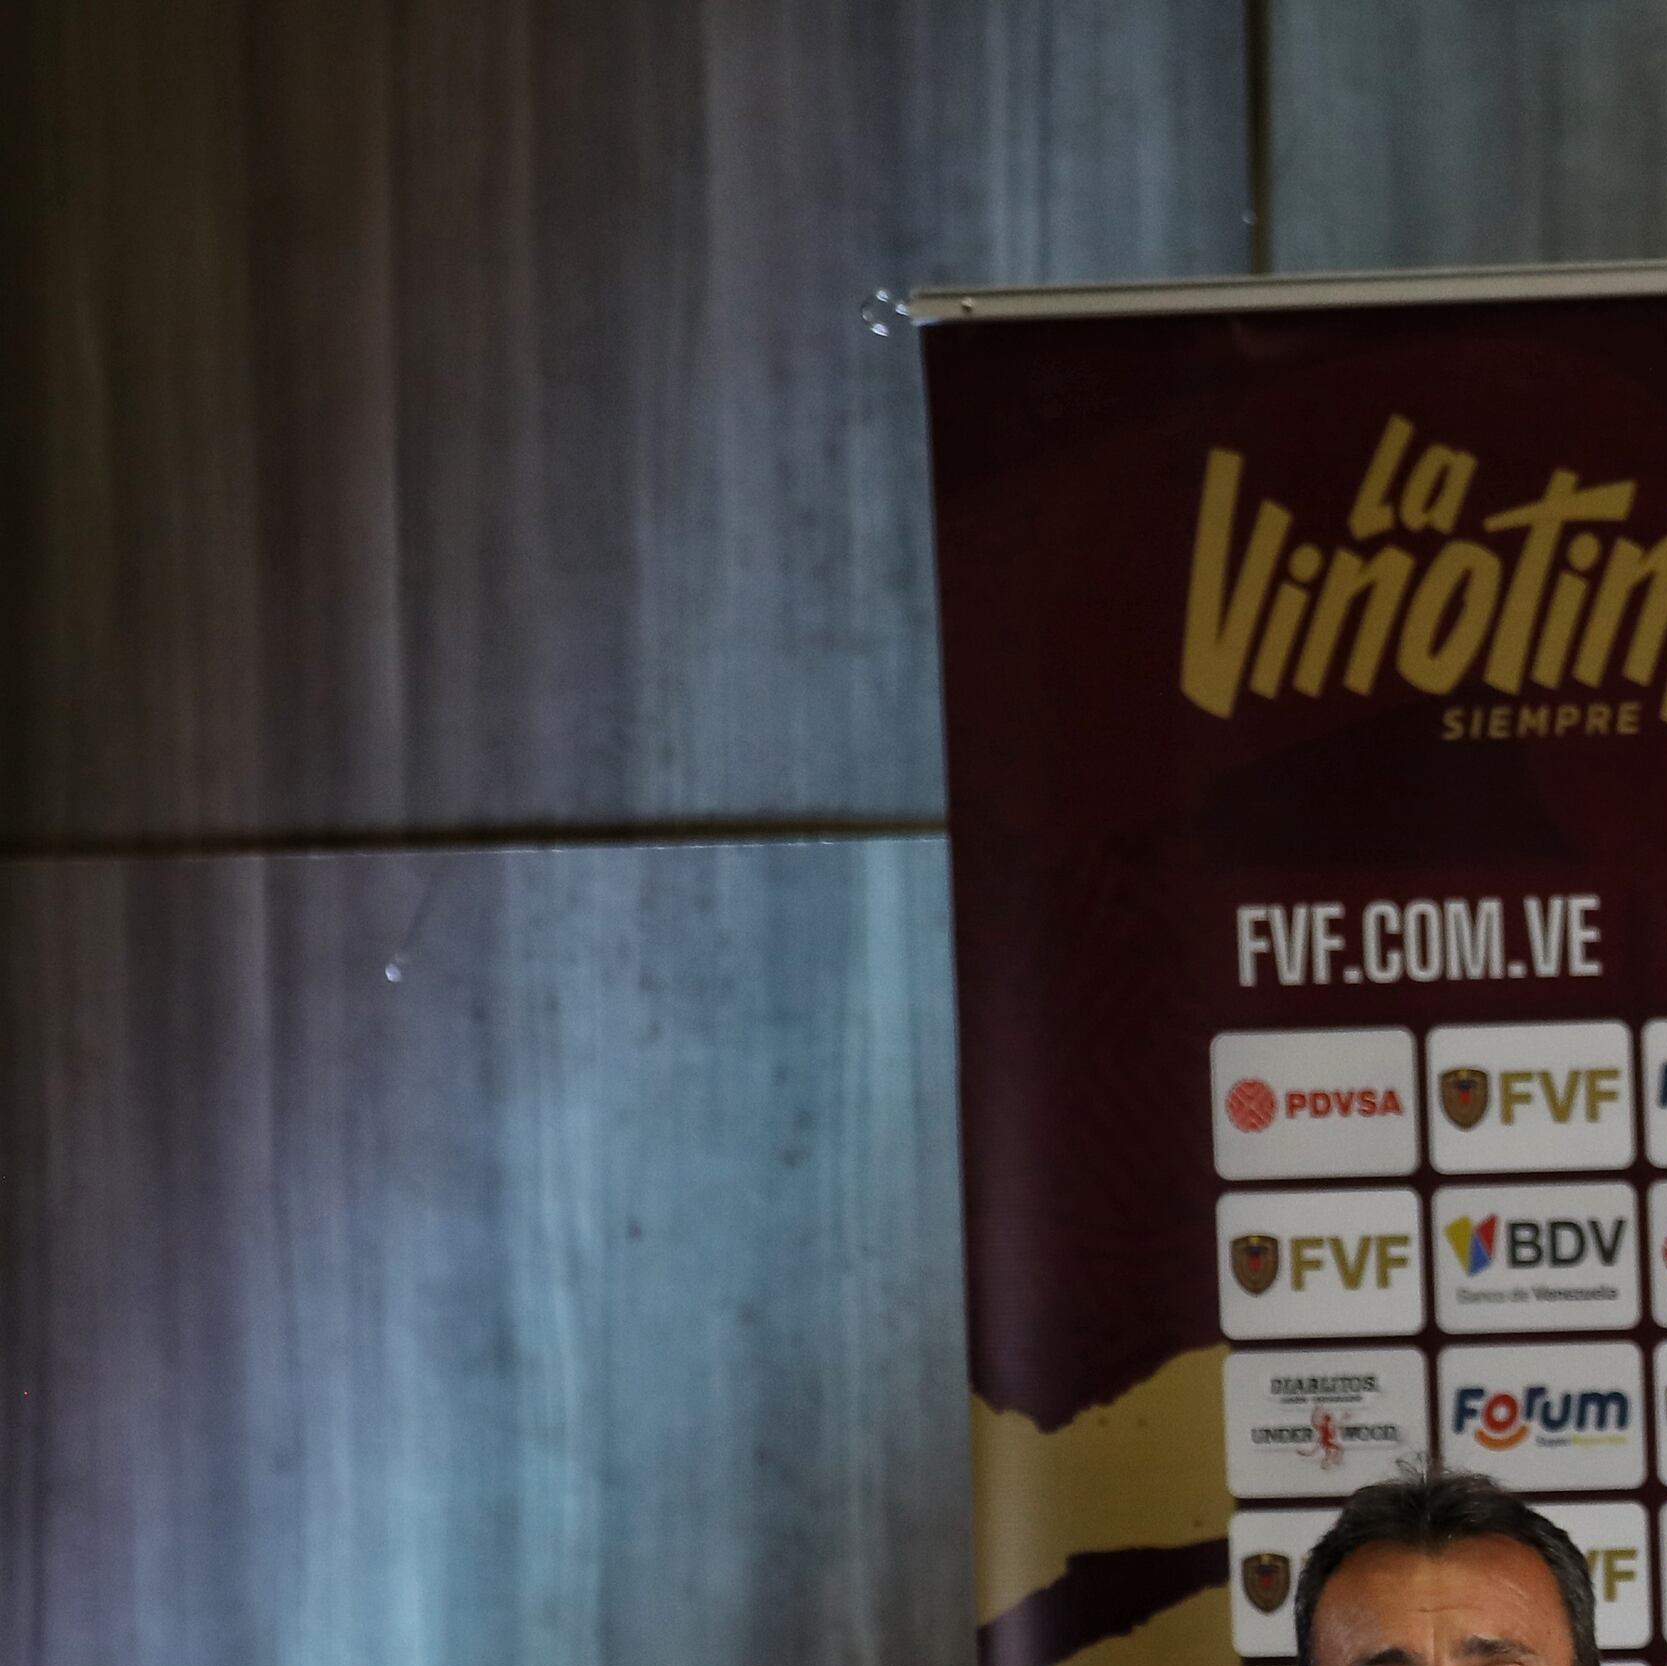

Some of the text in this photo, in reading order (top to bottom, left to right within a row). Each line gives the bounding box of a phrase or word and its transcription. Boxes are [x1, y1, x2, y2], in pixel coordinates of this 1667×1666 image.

[1348, 414, 1478, 541] La
[1443, 702, 1641, 740] SIEMPRE
[1237, 895, 1602, 986] FVF.COM.VE
[1285, 1088, 1403, 1119] PDVSA
[1499, 1068, 1621, 1125] FVF
[1289, 1234, 1411, 1291] FVF
[1506, 1218, 1626, 1268] BDV
[1452, 1384, 1631, 1441] Forum
